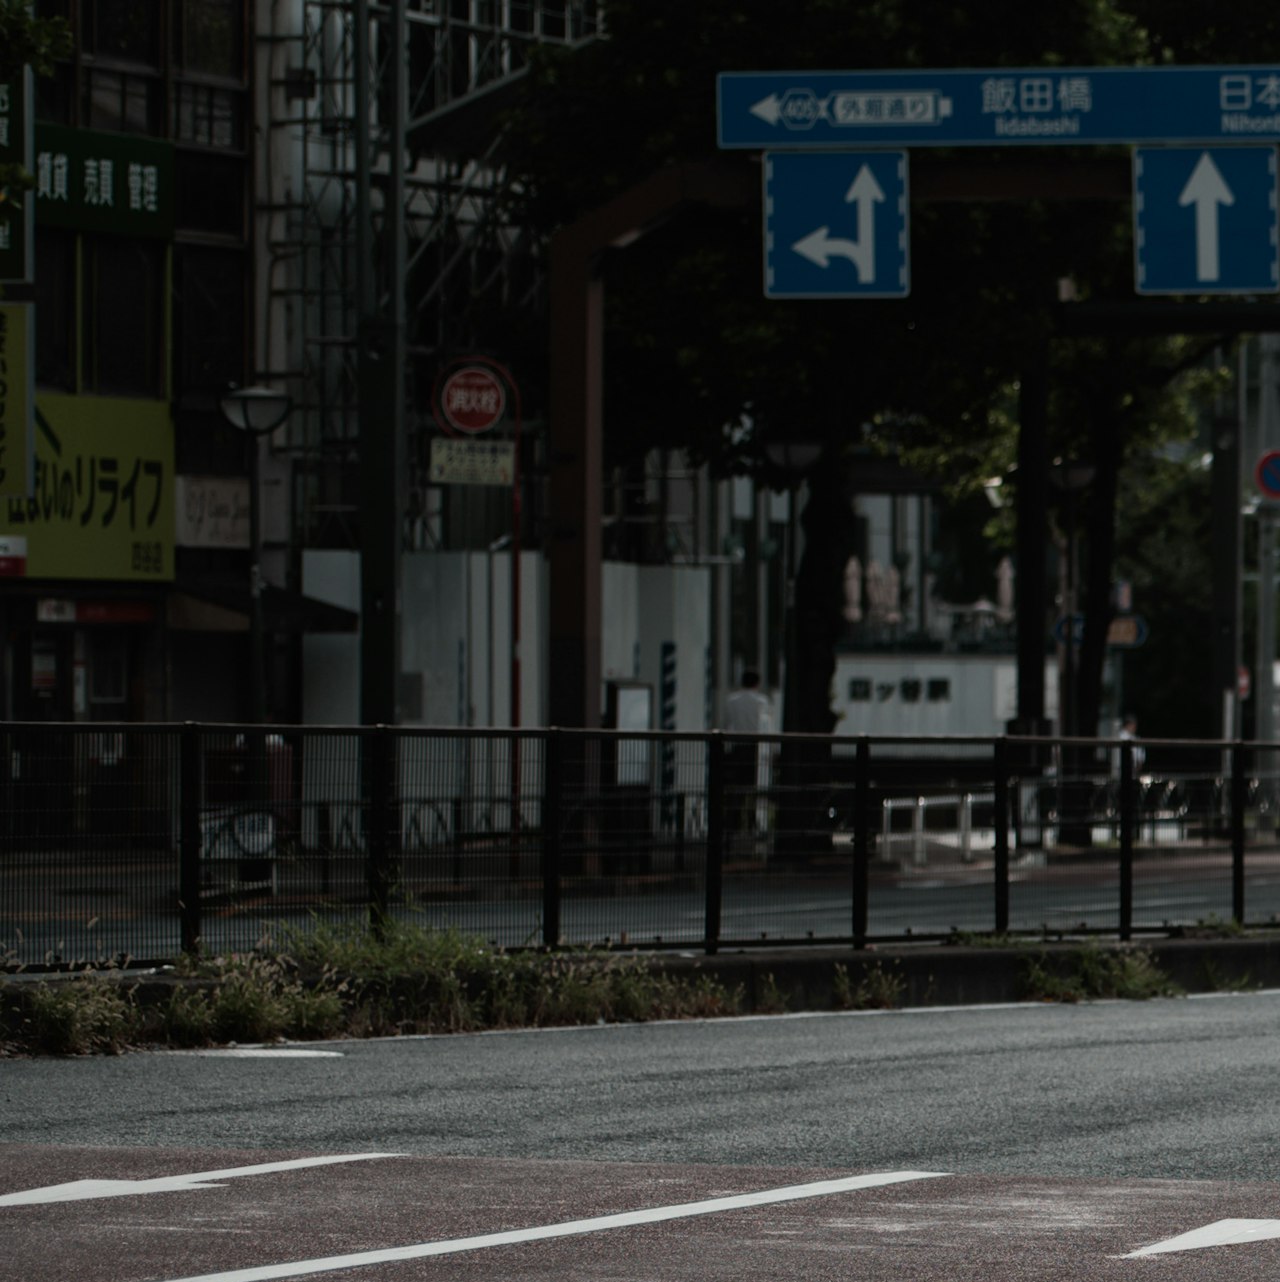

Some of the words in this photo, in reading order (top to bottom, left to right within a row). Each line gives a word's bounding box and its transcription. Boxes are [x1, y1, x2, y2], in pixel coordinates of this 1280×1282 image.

[842, 95, 932, 119] 外堀通り
[980, 76, 1092, 114] 飯田橋
[994, 115, 1081, 136] Iidabashi
[37, 151, 69, 201] 賃貸
[83, 156, 115, 207] 売買
[127, 161, 159, 213] 管理
[448, 386, 498, 414] 消火栓
